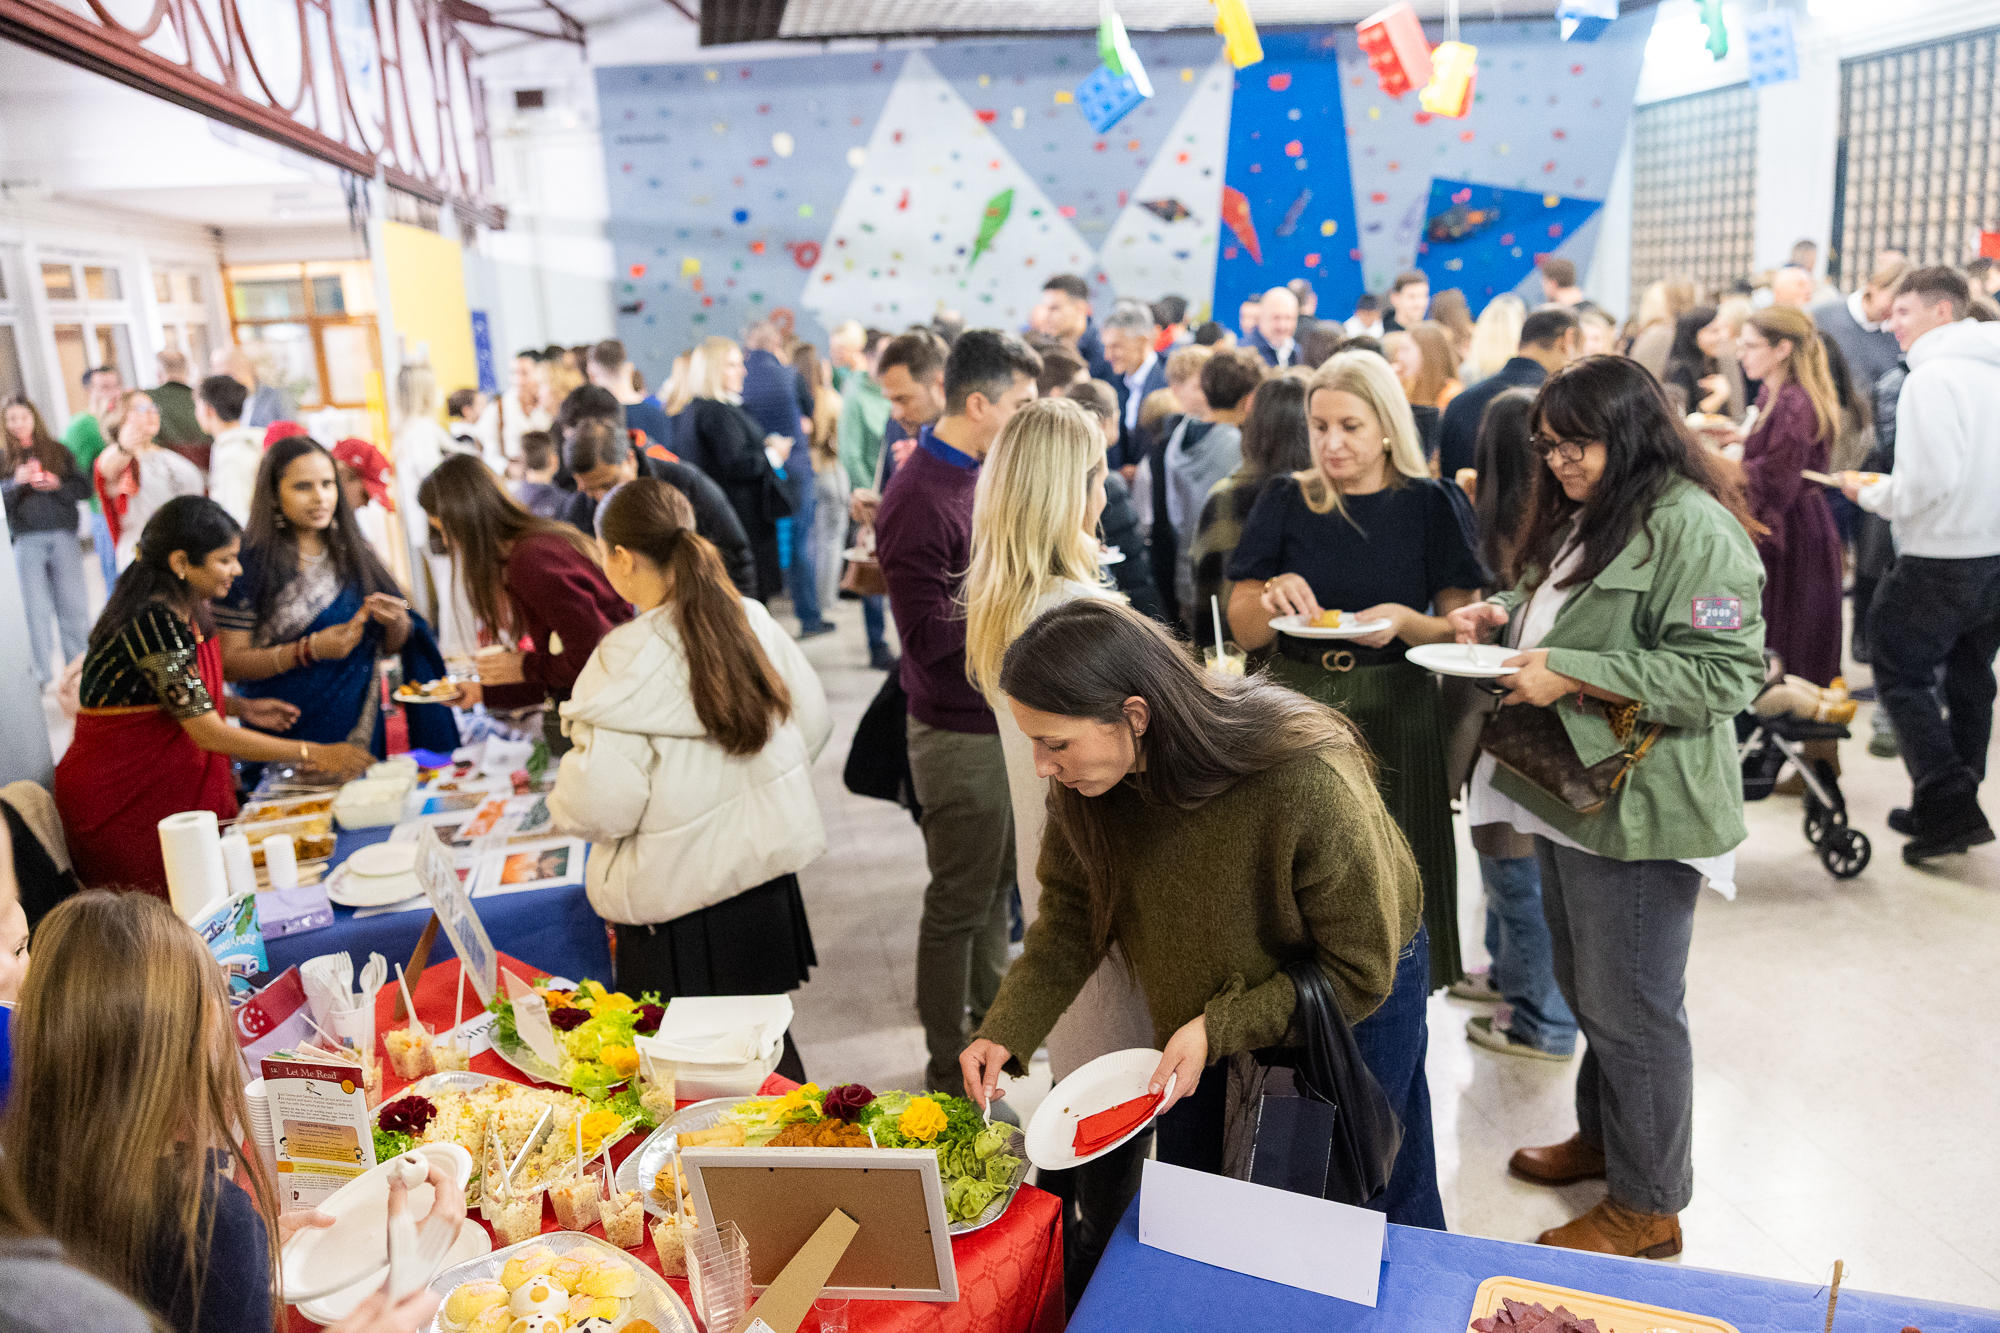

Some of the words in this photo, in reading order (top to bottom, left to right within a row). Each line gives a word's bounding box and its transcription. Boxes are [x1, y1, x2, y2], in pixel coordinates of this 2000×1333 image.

[286, 1067, 299, 1077] Let
[301, 1068, 314, 1078] Me
[316, 1069, 337, 1080] Read
